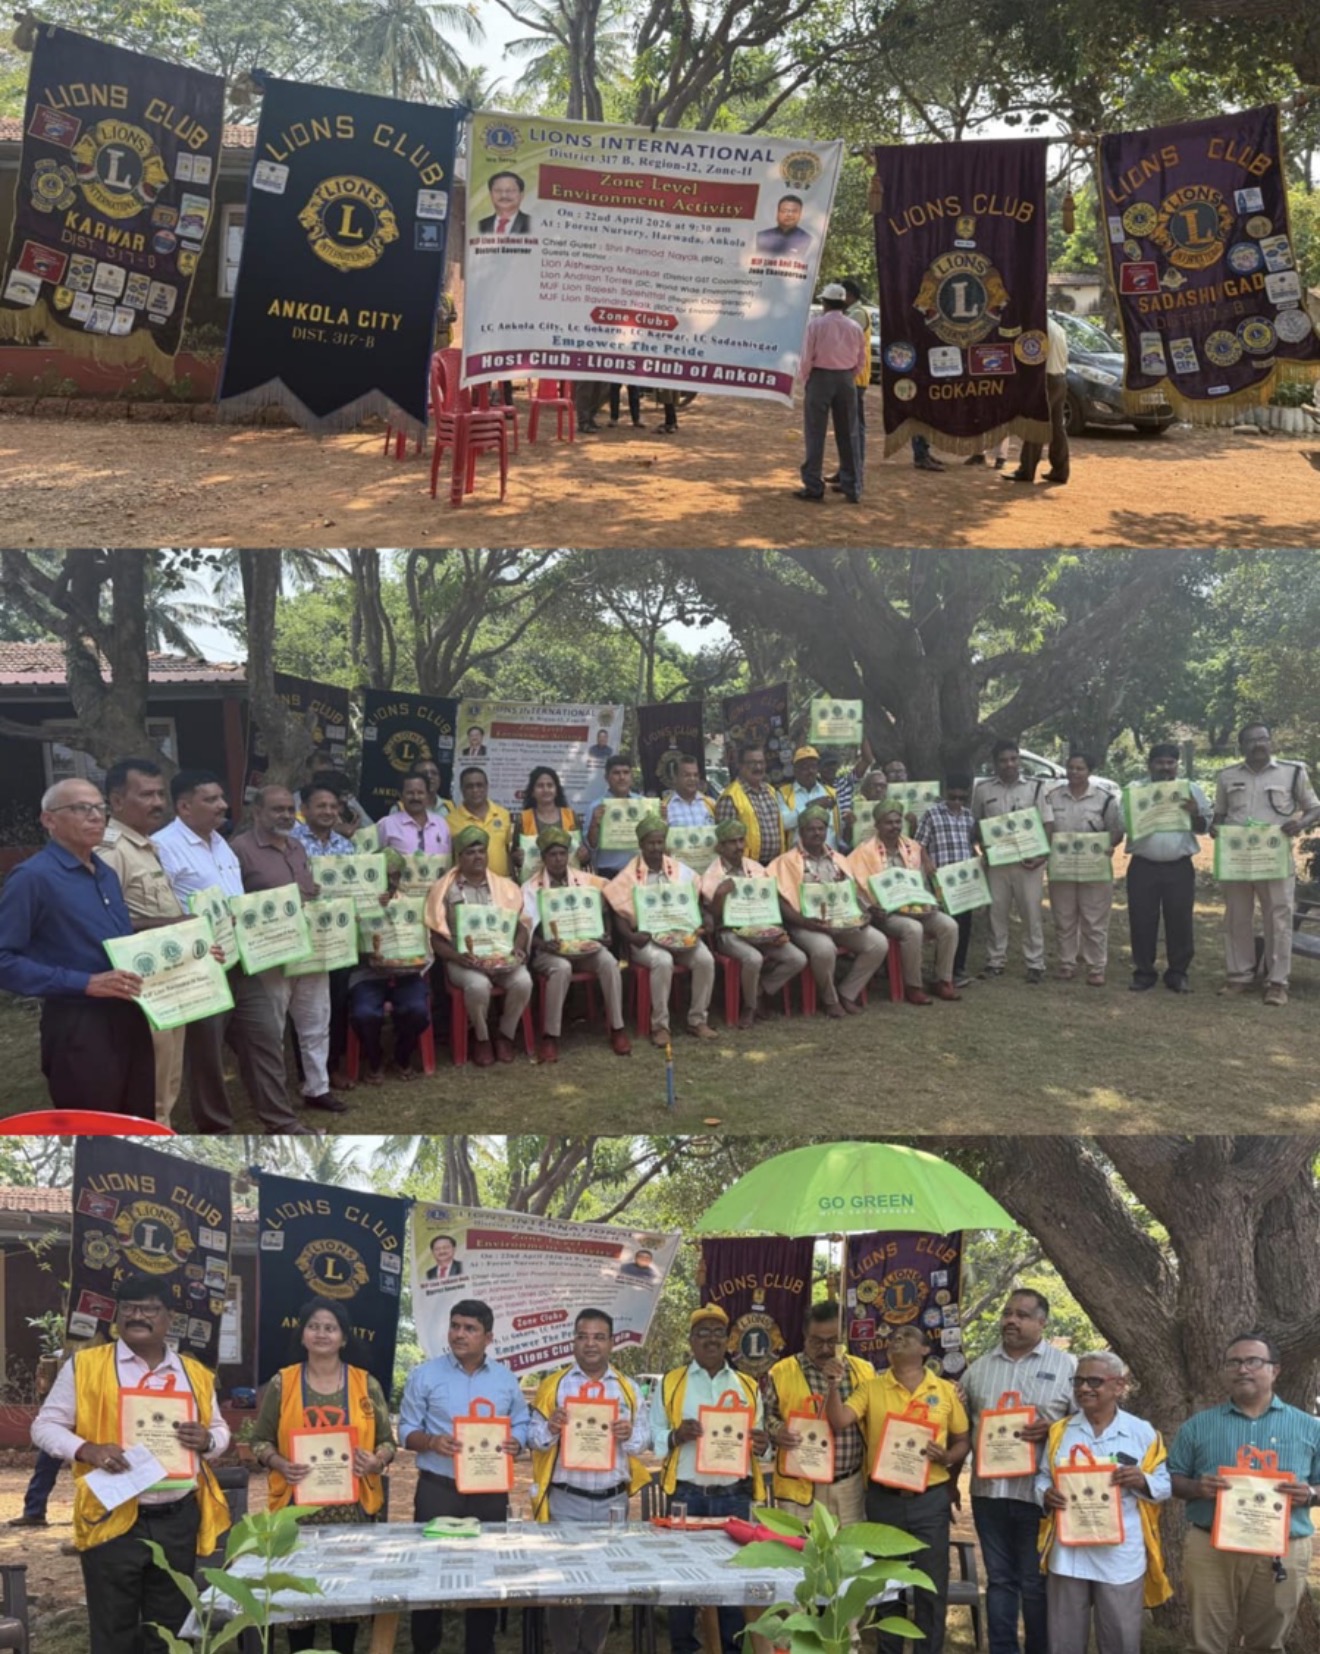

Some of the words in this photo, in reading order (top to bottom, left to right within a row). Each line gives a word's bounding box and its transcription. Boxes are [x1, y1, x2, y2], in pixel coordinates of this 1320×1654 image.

[45, 83, 129, 109] LIONS
[144, 98, 210, 150] CLUB
[101, 126, 148, 152] LIONS
[265, 116, 355, 161] LIONS
[373, 124, 444, 186] CLUB
[529, 128, 592, 148] LIONS
[601, 137, 776, 164] INTERNATIONAL
[549, 148, 596, 163] District
[601, 155, 618, 165] 317
[104, 148, 134, 190] L
[1107, 145, 1180, 204] LIONS
[325, 180, 383, 205] LIONS
[600, 174, 645, 189] Zone
[652, 178, 699, 196] Level
[1171, 185, 1223, 206] LIONS
[551, 184, 665, 208] Environment
[673, 199, 744, 217] Activity
[337, 204, 364, 239] L
[557, 208, 573, 218] On
[585, 210, 611, 223] 22nd
[614, 212, 644, 227] April
[675, 221, 686, 230] at
[715, 226, 732, 234] am
[889, 195, 962, 236] LIONS
[973, 194, 1035, 223] CLUB
[1179, 209, 1214, 245] L
[65, 210, 146, 253] KARWAR
[540, 219, 554, 228] At
[564, 221, 599, 233] Forest
[602, 226, 648, 240] Nursery,
[652, 231, 705, 245] Harwada,
[708, 237, 746, 248] Ankola
[541, 247, 570, 257] Guests
[571, 249, 581, 257] of
[542, 237, 568, 248] Chief
[569, 240, 598, 250] Guest
[605, 243, 624, 253] Shri
[625, 245, 665, 259] Pramod
[668, 251, 700, 261] Nayak
[541, 259, 562, 269] Lion
[564, 260, 614, 274] Aishwarya
[936, 254, 988, 275] LIONS
[540, 271, 561, 280] Lion
[605, 275, 633, 286] Torres
[540, 282, 558, 291] MJF
[562, 283, 583, 292] Lion
[585, 284, 618, 295] Rajesh
[539, 293, 558, 301] MJF
[951, 281, 979, 318] L
[267, 299, 349, 326] ANKOLA
[358, 310, 403, 331] CITY
[497, 322, 535, 331] Ankola
[538, 322, 564, 332] City,
[598, 310, 630, 323] Zone
[634, 312, 670, 328] Clubs
[332, 332, 376, 349] 317-B
[552, 335, 627, 351] Empower
[631, 340, 659, 353] The
[664, 343, 706, 358] Pride
[481, 353, 523, 369] Host
[529, 352, 571, 366] Club
[587, 354, 636, 370] Lions
[641, 358, 684, 376] Club
[690, 363, 708, 378] of
[713, 366, 777, 387] Ankola
[928, 379, 1005, 400] GOKARN
[368, 703, 409, 727] LIONS
[416, 705, 452, 735] CLUB
[402, 744, 415, 760] L
[88, 1173, 156, 1194] LIONS
[171, 1186, 223, 1227] CLUB
[818, 1196, 845, 1210] GO
[850, 1193, 914, 1209] GREEN
[135, 1205, 176, 1227] LIONS
[265, 1200, 332, 1230] LIONS
[344, 1206, 399, 1250] CLUB
[140, 1223, 166, 1254] L
[313, 1241, 358, 1260] LIONS
[324, 1257, 343, 1280] L
[849, 1242, 899, 1280] LIONS
[709, 1274, 758, 1302] LIONS
[763, 1272, 804, 1295] CLUB
[893, 1284, 913, 1307] L
[516, 1316, 537, 1327] Zone
[350, 1326, 376, 1342] ITY
[494, 1339, 540, 1355] Empower
[542, 1332, 560, 1344] The
[749, 1333, 766, 1358] L
[519, 1348, 549, 1367] Lions
